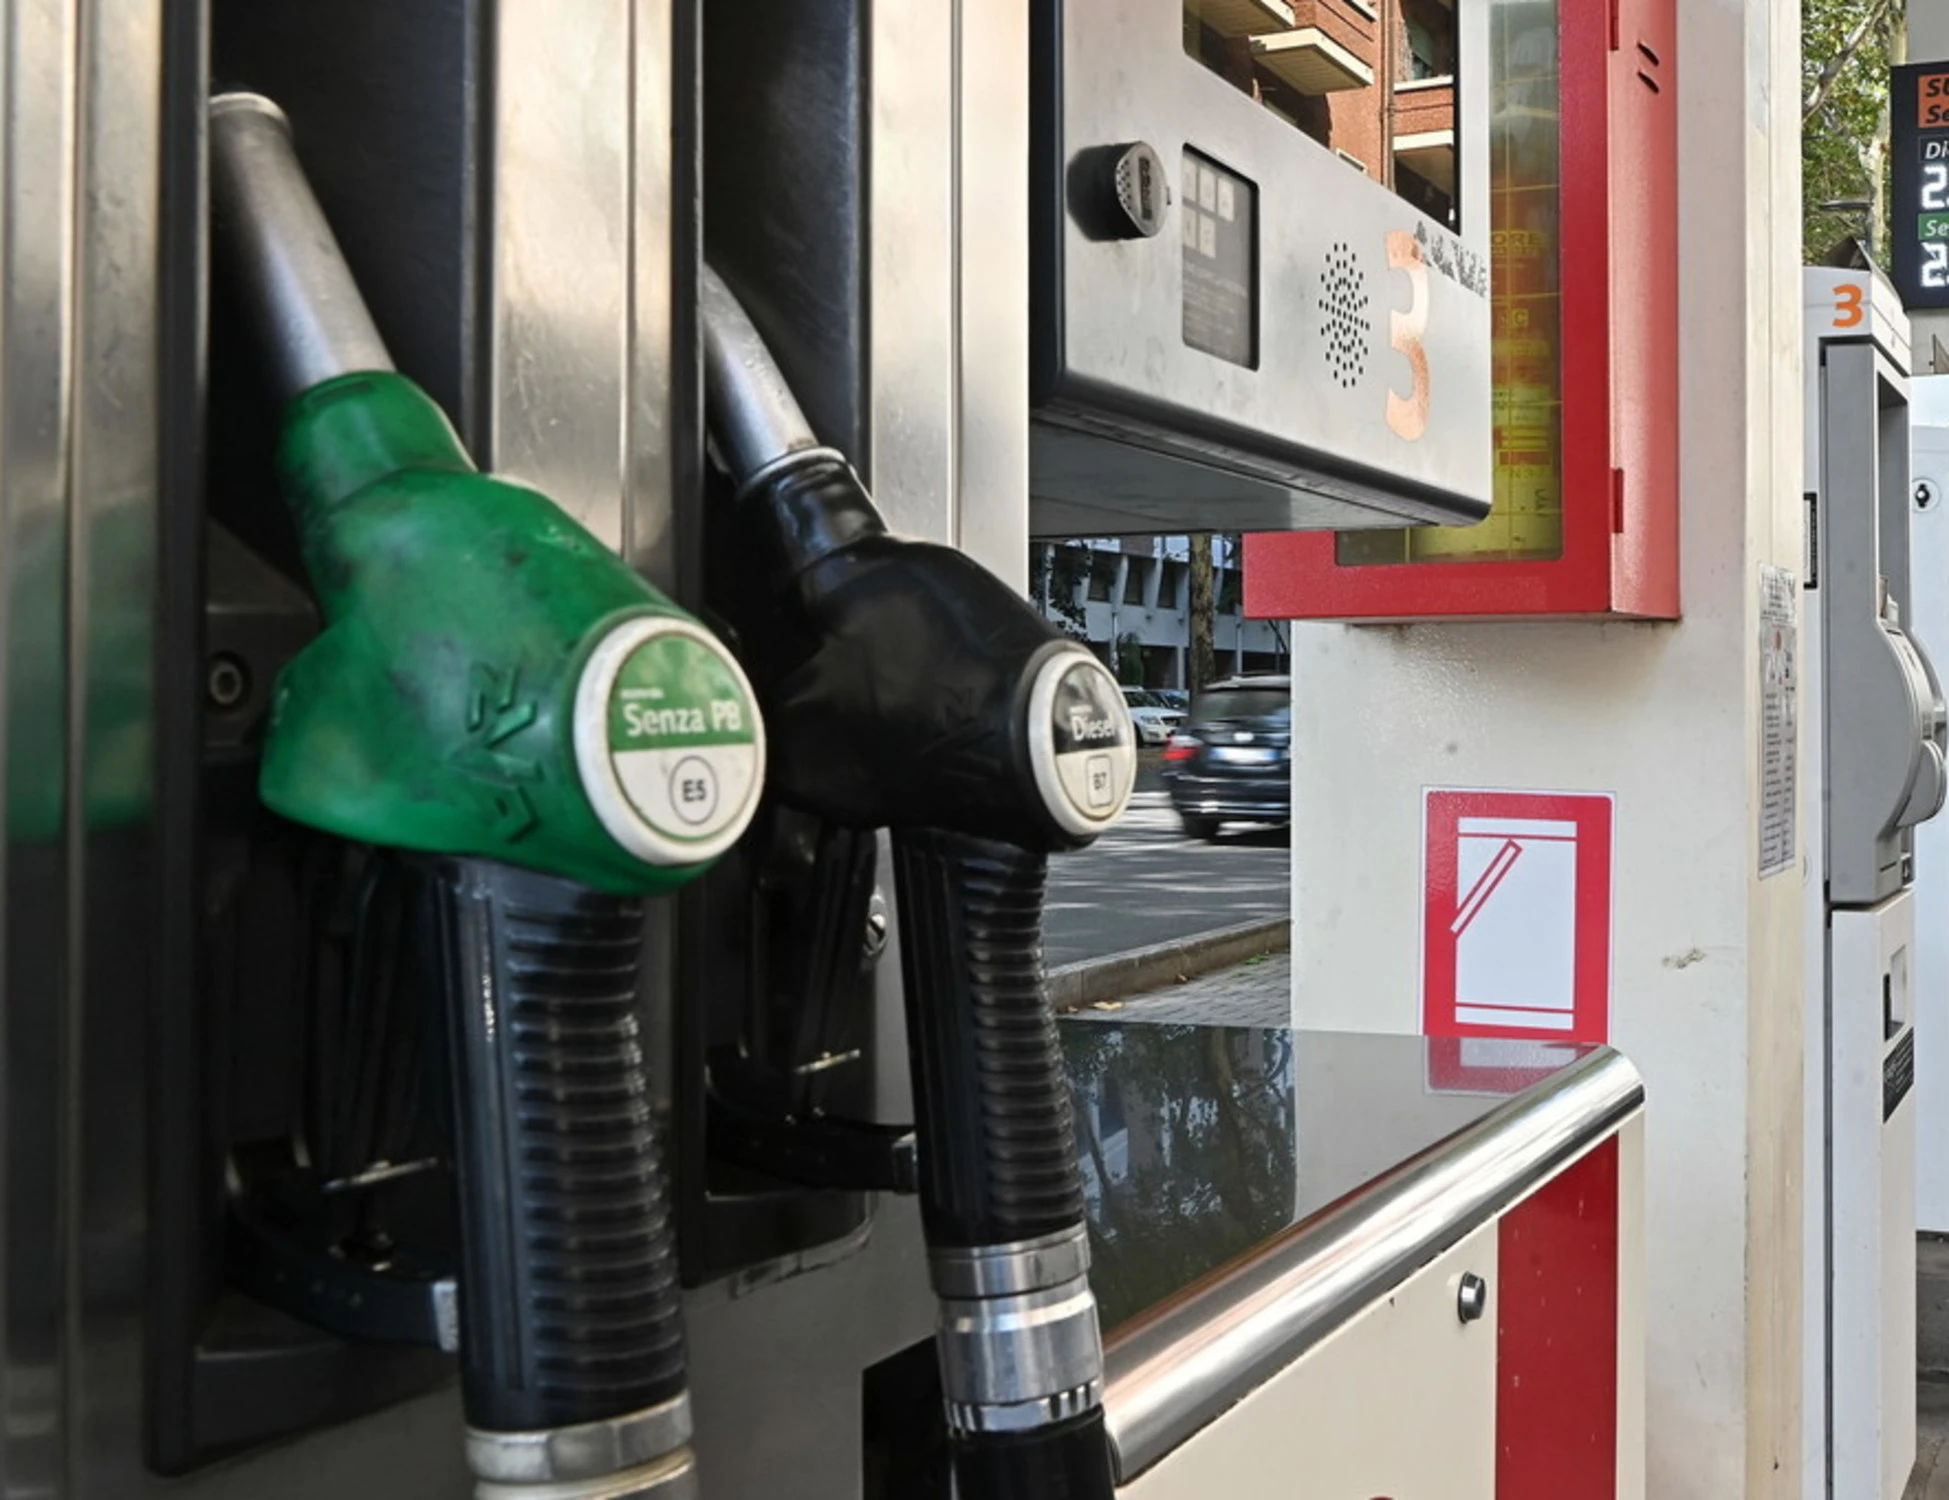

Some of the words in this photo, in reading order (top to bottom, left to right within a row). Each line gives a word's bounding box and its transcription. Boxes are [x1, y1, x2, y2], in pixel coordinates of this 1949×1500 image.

[1925, 140, 1949, 159] Di
[1832, 283, 1863, 328] 3
[1384, 230, 1430, 442] 3
[623, 702, 707, 737] Senza
[711, 699, 742, 732] PB
[1072, 711, 1116, 741] Diesel
[682, 780, 706, 802] E5
